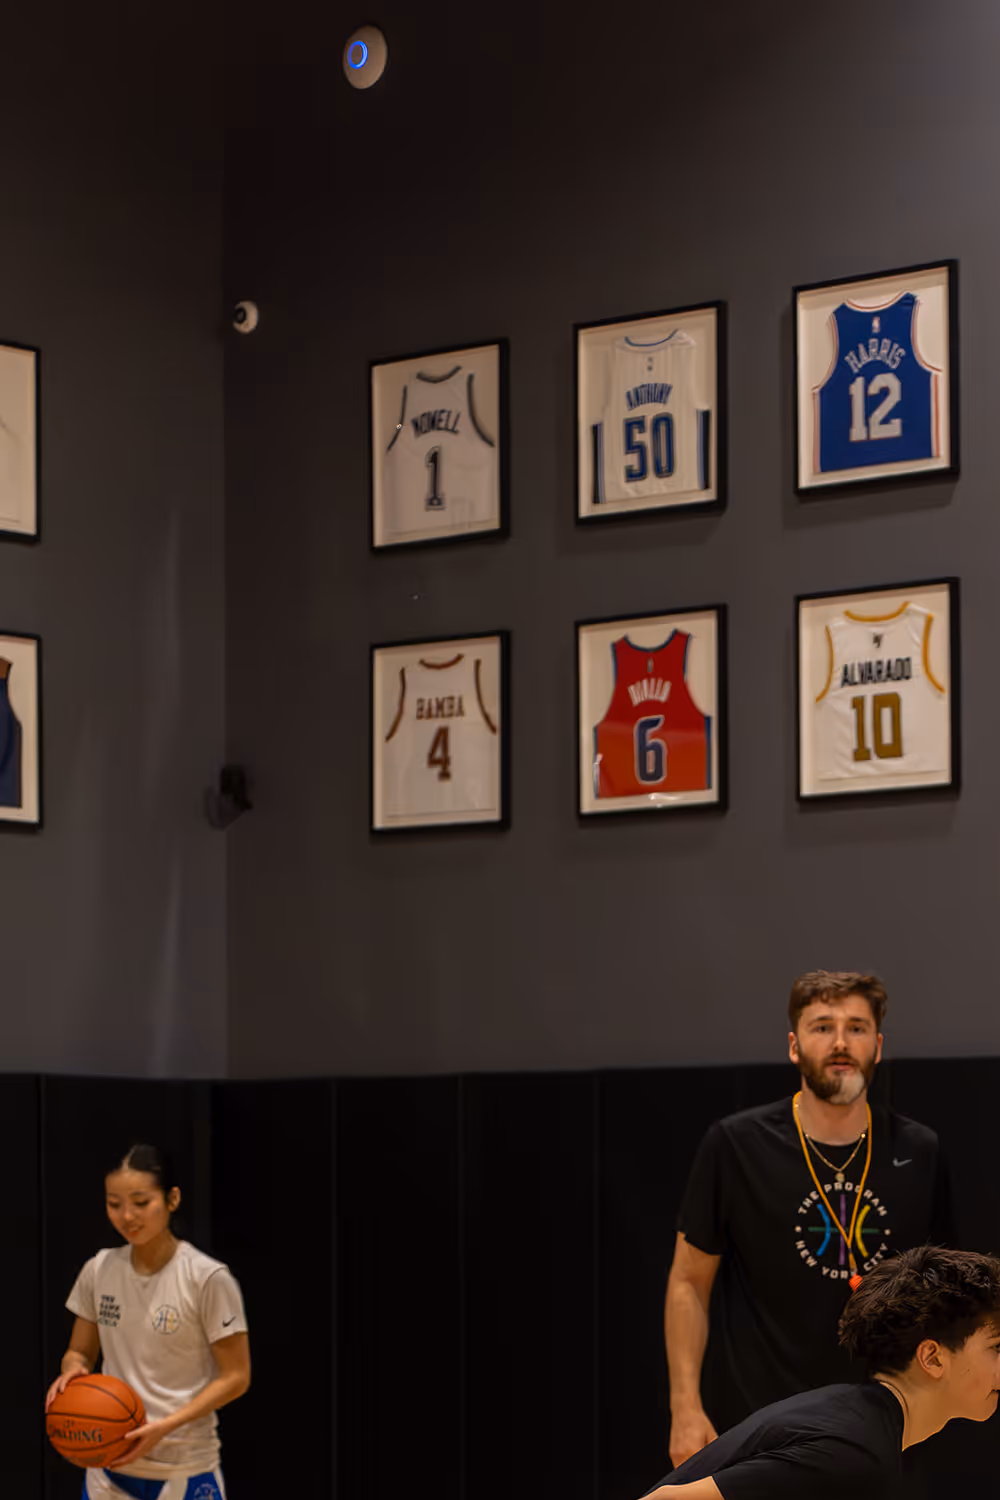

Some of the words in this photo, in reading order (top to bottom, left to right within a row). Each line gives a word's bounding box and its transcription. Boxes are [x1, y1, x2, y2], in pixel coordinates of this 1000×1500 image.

[844, 338, 906, 373] HARRIS
[625, 382, 674, 411] ANTHONY
[849, 372, 902, 442] 12
[623, 411, 675, 483] 50
[424, 445, 446, 512] 1
[840, 656, 912, 689] ALVARADO
[427, 726, 451, 782] 4
[633, 715, 667, 785] 6
[851, 692, 903, 762] 10
[798, 1190, 820, 1215] THE
[824, 1181, 888, 1217] PROGRAM
[795, 1240, 818, 1267] NEW
[820, 1266, 850, 1279] YOR
